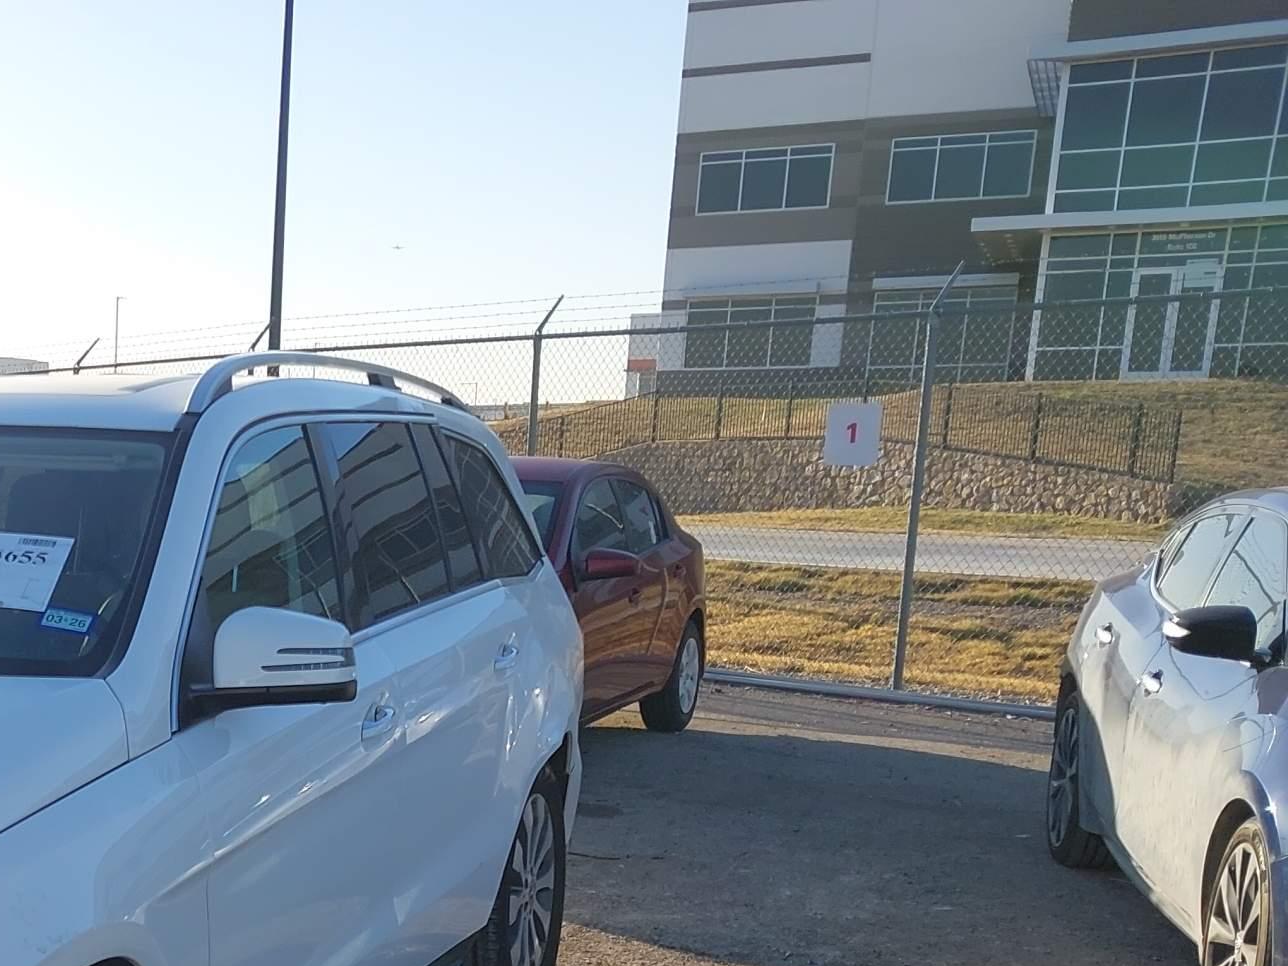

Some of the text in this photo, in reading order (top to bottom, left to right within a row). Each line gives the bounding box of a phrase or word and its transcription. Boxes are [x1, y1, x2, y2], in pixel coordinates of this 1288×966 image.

[846, 422, 857, 444] 1
[46, 613, 87, 629] 03 26
